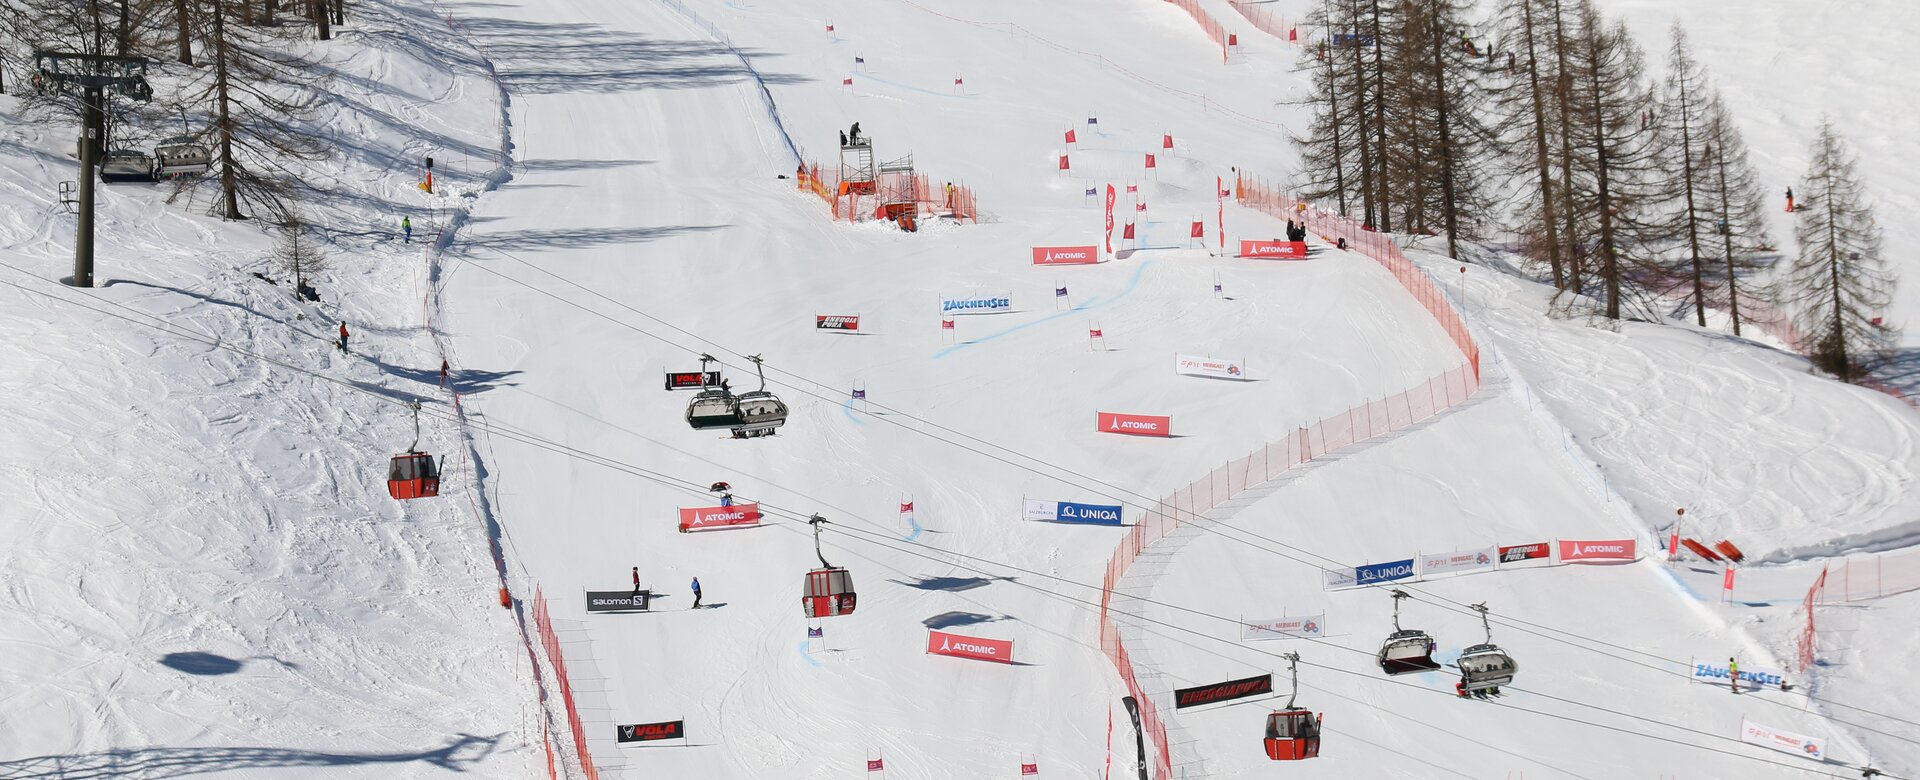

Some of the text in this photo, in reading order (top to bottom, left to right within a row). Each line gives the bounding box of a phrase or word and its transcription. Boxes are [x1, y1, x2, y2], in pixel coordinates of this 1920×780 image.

[1259, 246, 1293, 254] ATOMIC
[1054, 252, 1086, 260] ATOMIC
[943, 298, 1009, 311] ZAUCHENSEE
[825, 316, 857, 324] ENERGIA
[676, 374, 702, 382] VOLA
[1121, 421, 1157, 430] ATOMIC
[705, 512, 745, 522] ATOMIC
[1080, 508, 1118, 520] UNIQA
[1507, 545, 1539, 554] ENERGIA
[1584, 545, 1624, 553] ATOMIC
[1504, 552, 1526, 562] PURA
[1377, 565, 1412, 579] UNIQA
[592, 598, 632, 606] salomon
[953, 643, 996, 655] ATOMIC
[1695, 663, 1781, 685] ZAUCENSEE
[635, 723, 675, 736] VOLA
